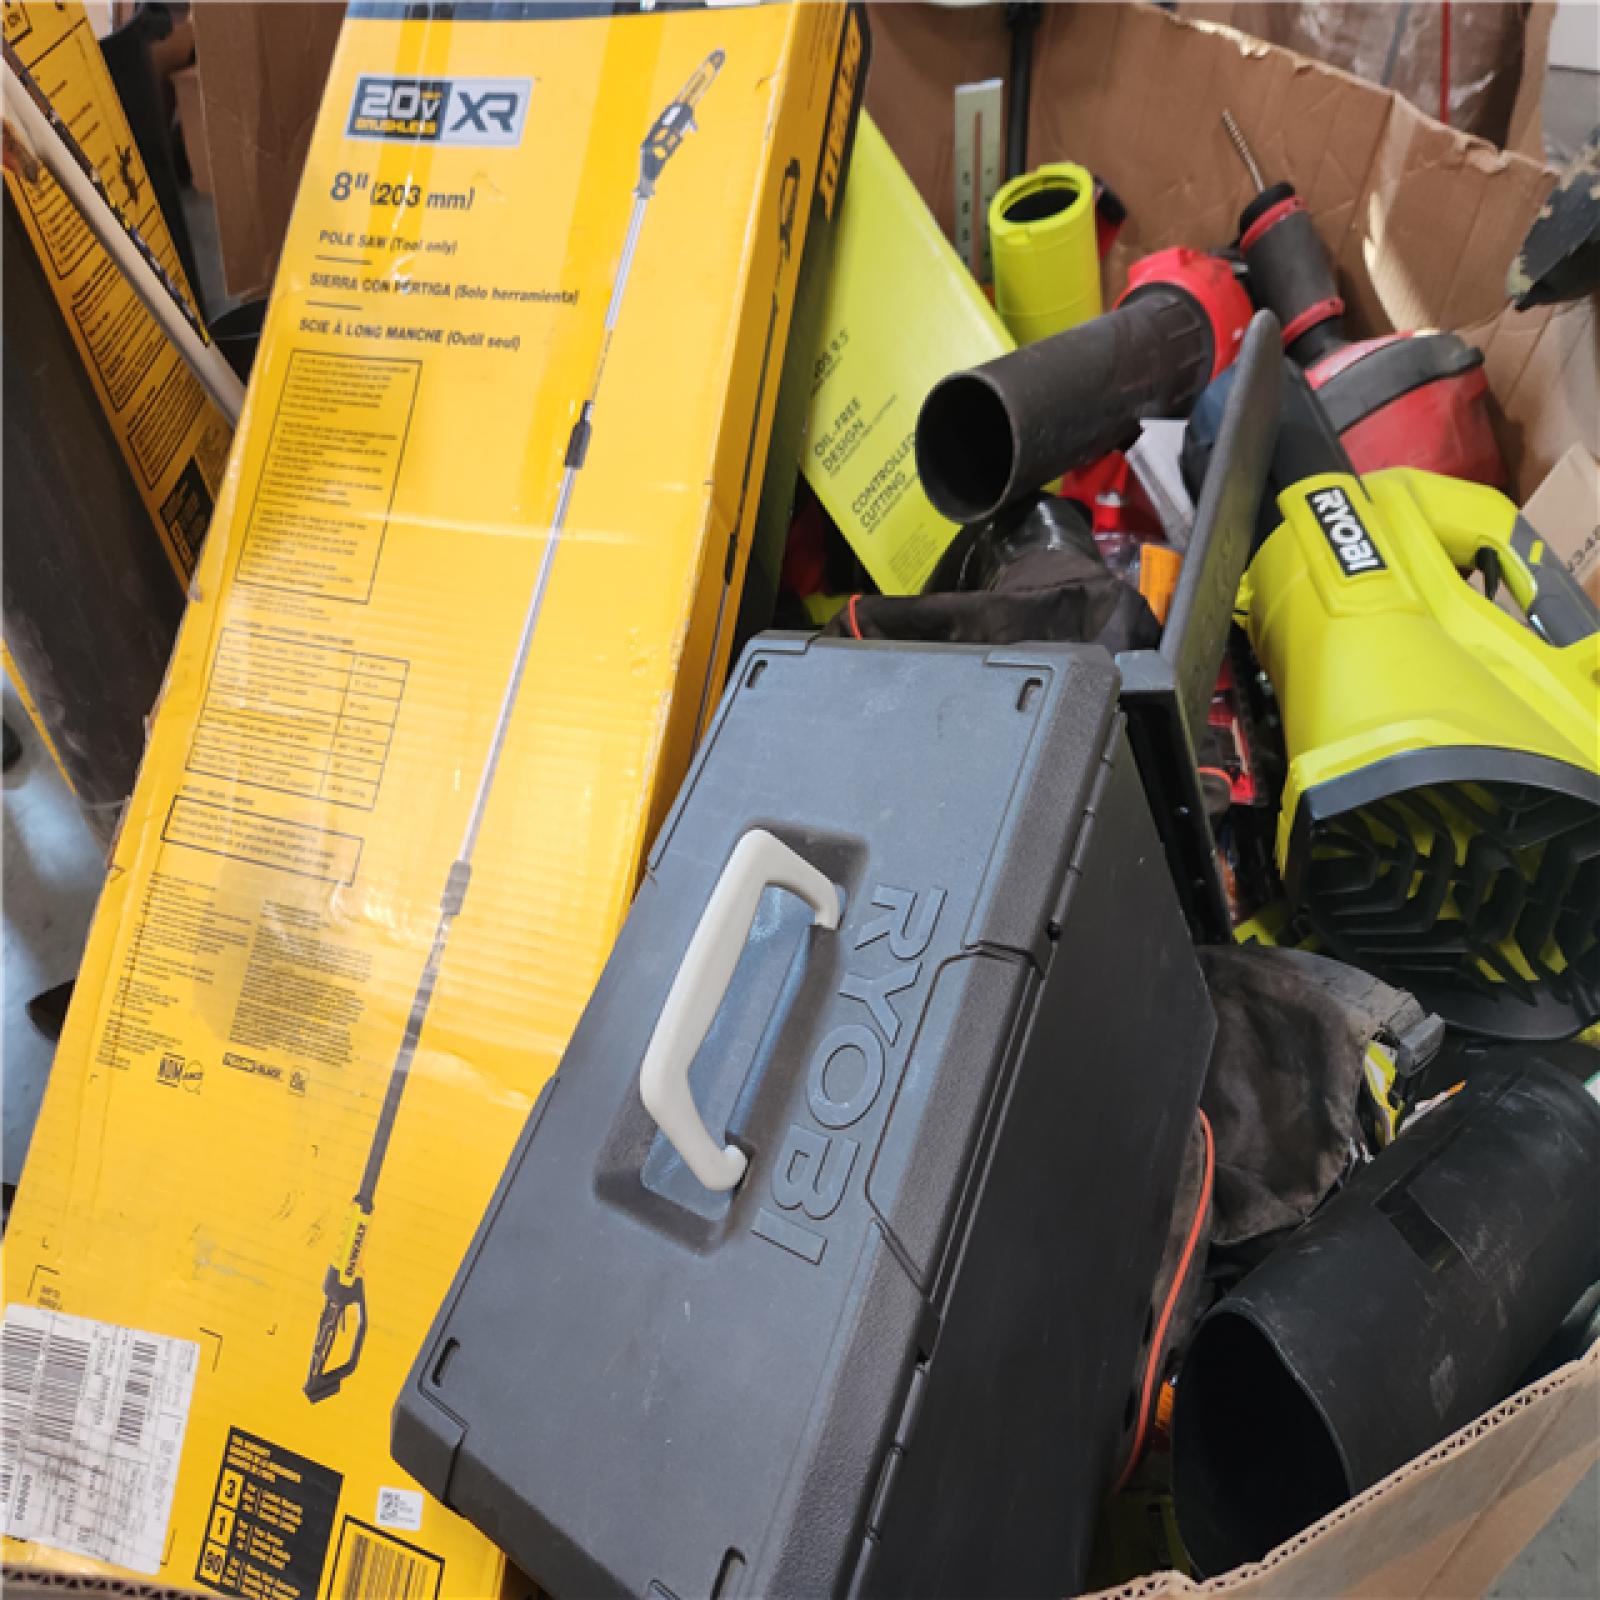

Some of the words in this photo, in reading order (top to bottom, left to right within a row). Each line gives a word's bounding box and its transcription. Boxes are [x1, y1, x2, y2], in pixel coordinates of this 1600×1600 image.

[451, 91, 518, 132] XR
[370, 181, 422, 208] (203
[426, 186, 476, 210] mm)
[319, 229, 355, 246] POLE
[309, 272, 358, 291] SIERRA
[362, 276, 390, 293] CON
[299, 317, 329, 335] SCIE
[385, 326, 443, 342] MANCHE
[1311, 487, 1381, 571] RYOBI
[750, 883, 948, 1266] RYOBI
